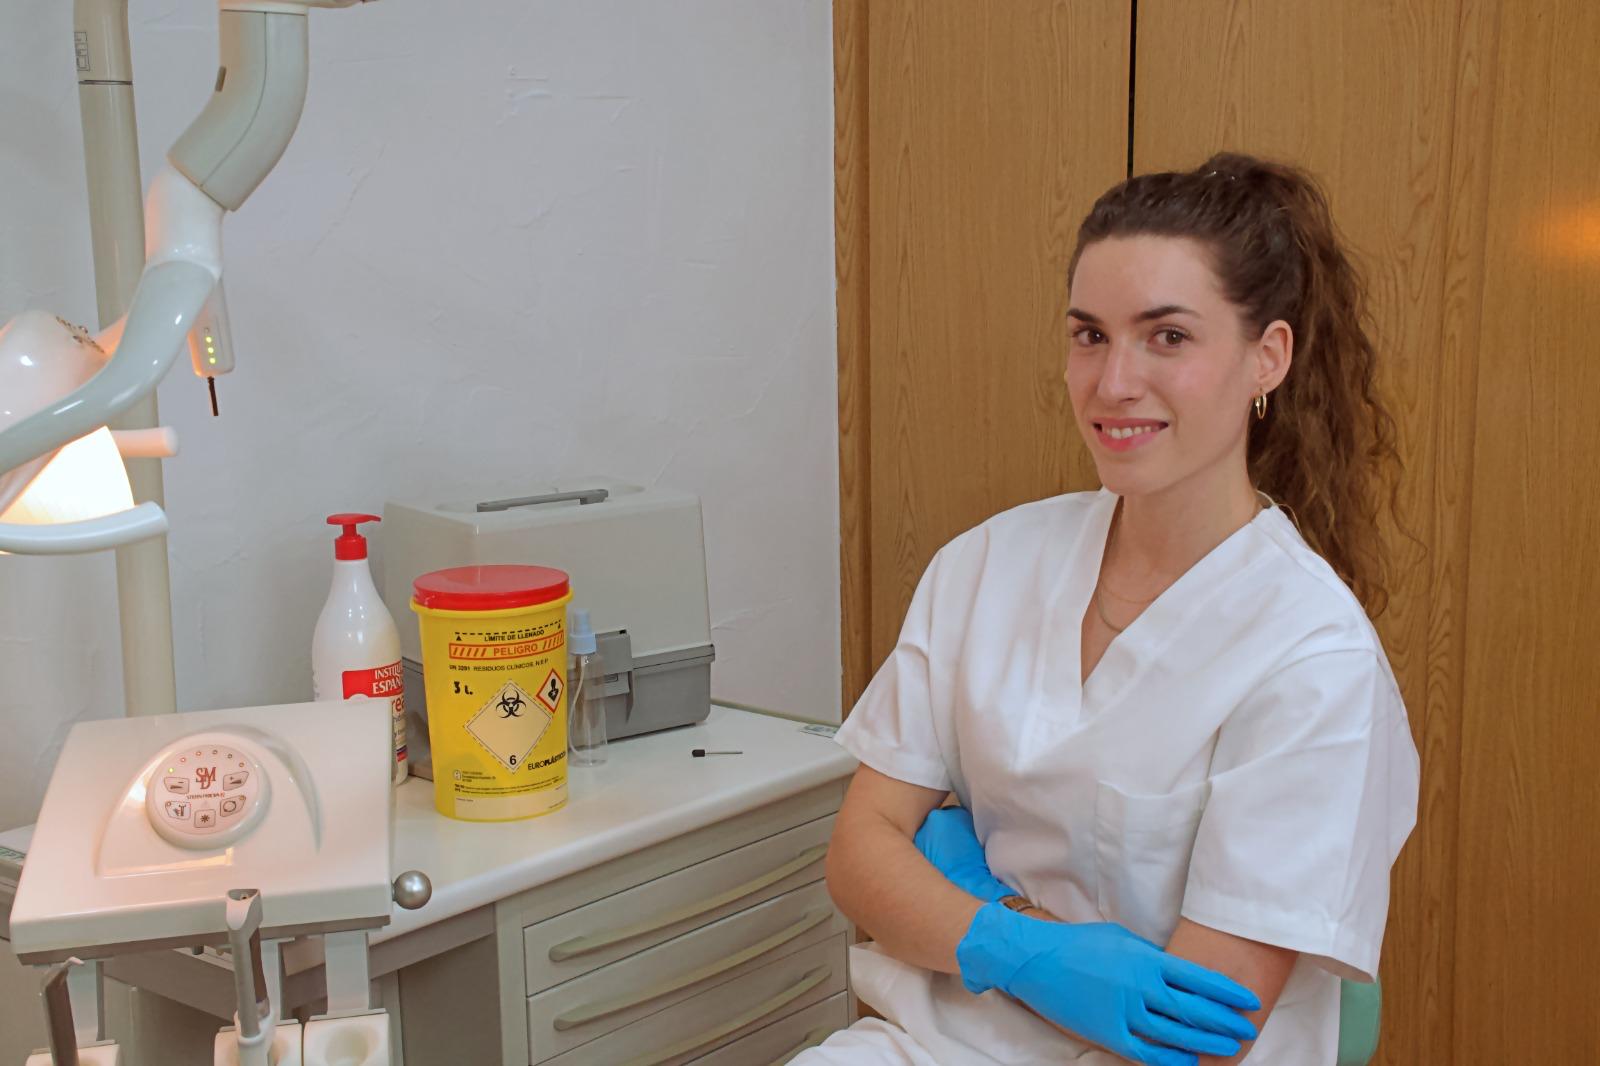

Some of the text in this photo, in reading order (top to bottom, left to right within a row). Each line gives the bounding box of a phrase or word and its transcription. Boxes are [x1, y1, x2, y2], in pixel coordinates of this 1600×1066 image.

[517, 629, 545, 639] LLENADO
[493, 643, 538, 656] PELIGRO
[454, 681, 461, 694] 3
[509, 755, 517, 765] 6
